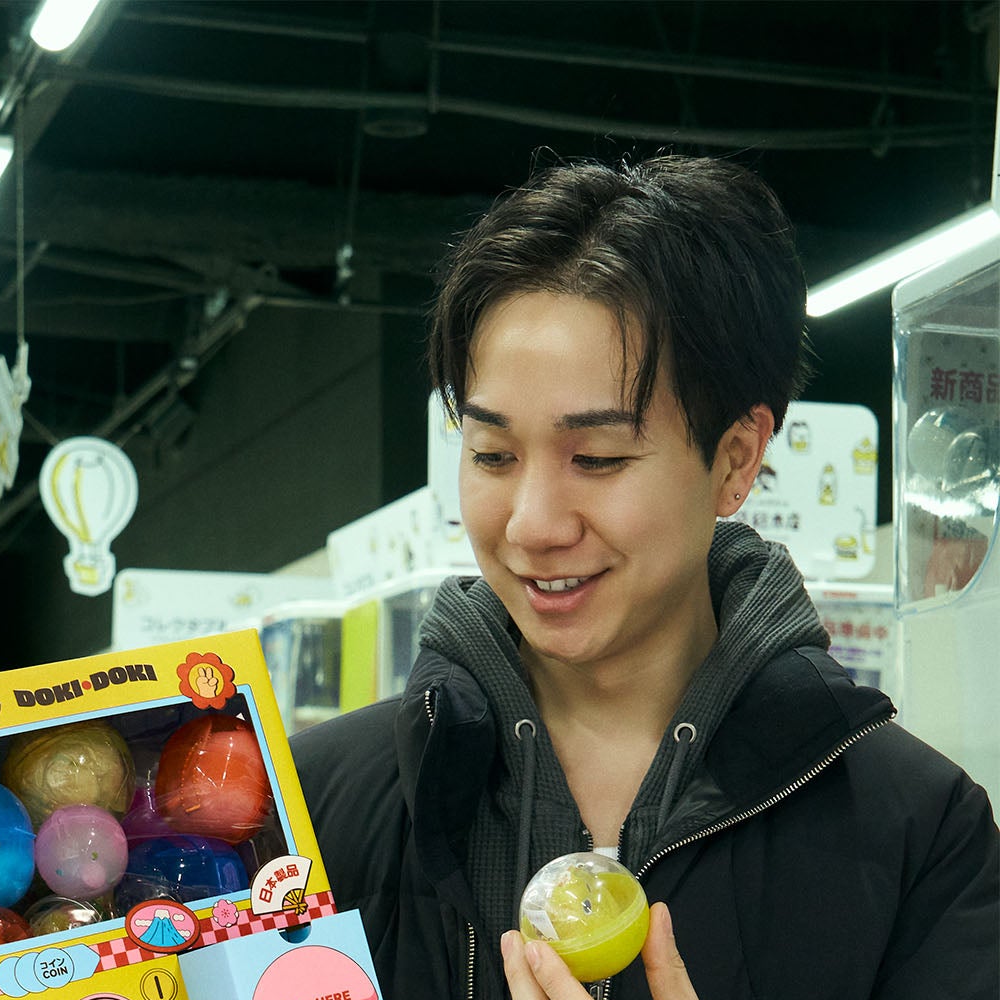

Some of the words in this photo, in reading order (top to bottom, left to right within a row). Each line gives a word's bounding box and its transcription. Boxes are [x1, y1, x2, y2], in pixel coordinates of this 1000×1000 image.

[259, 864, 299, 903] 日本製品
[40, 958, 65, 970] コイン
[43, 966, 68, 979] COIN
